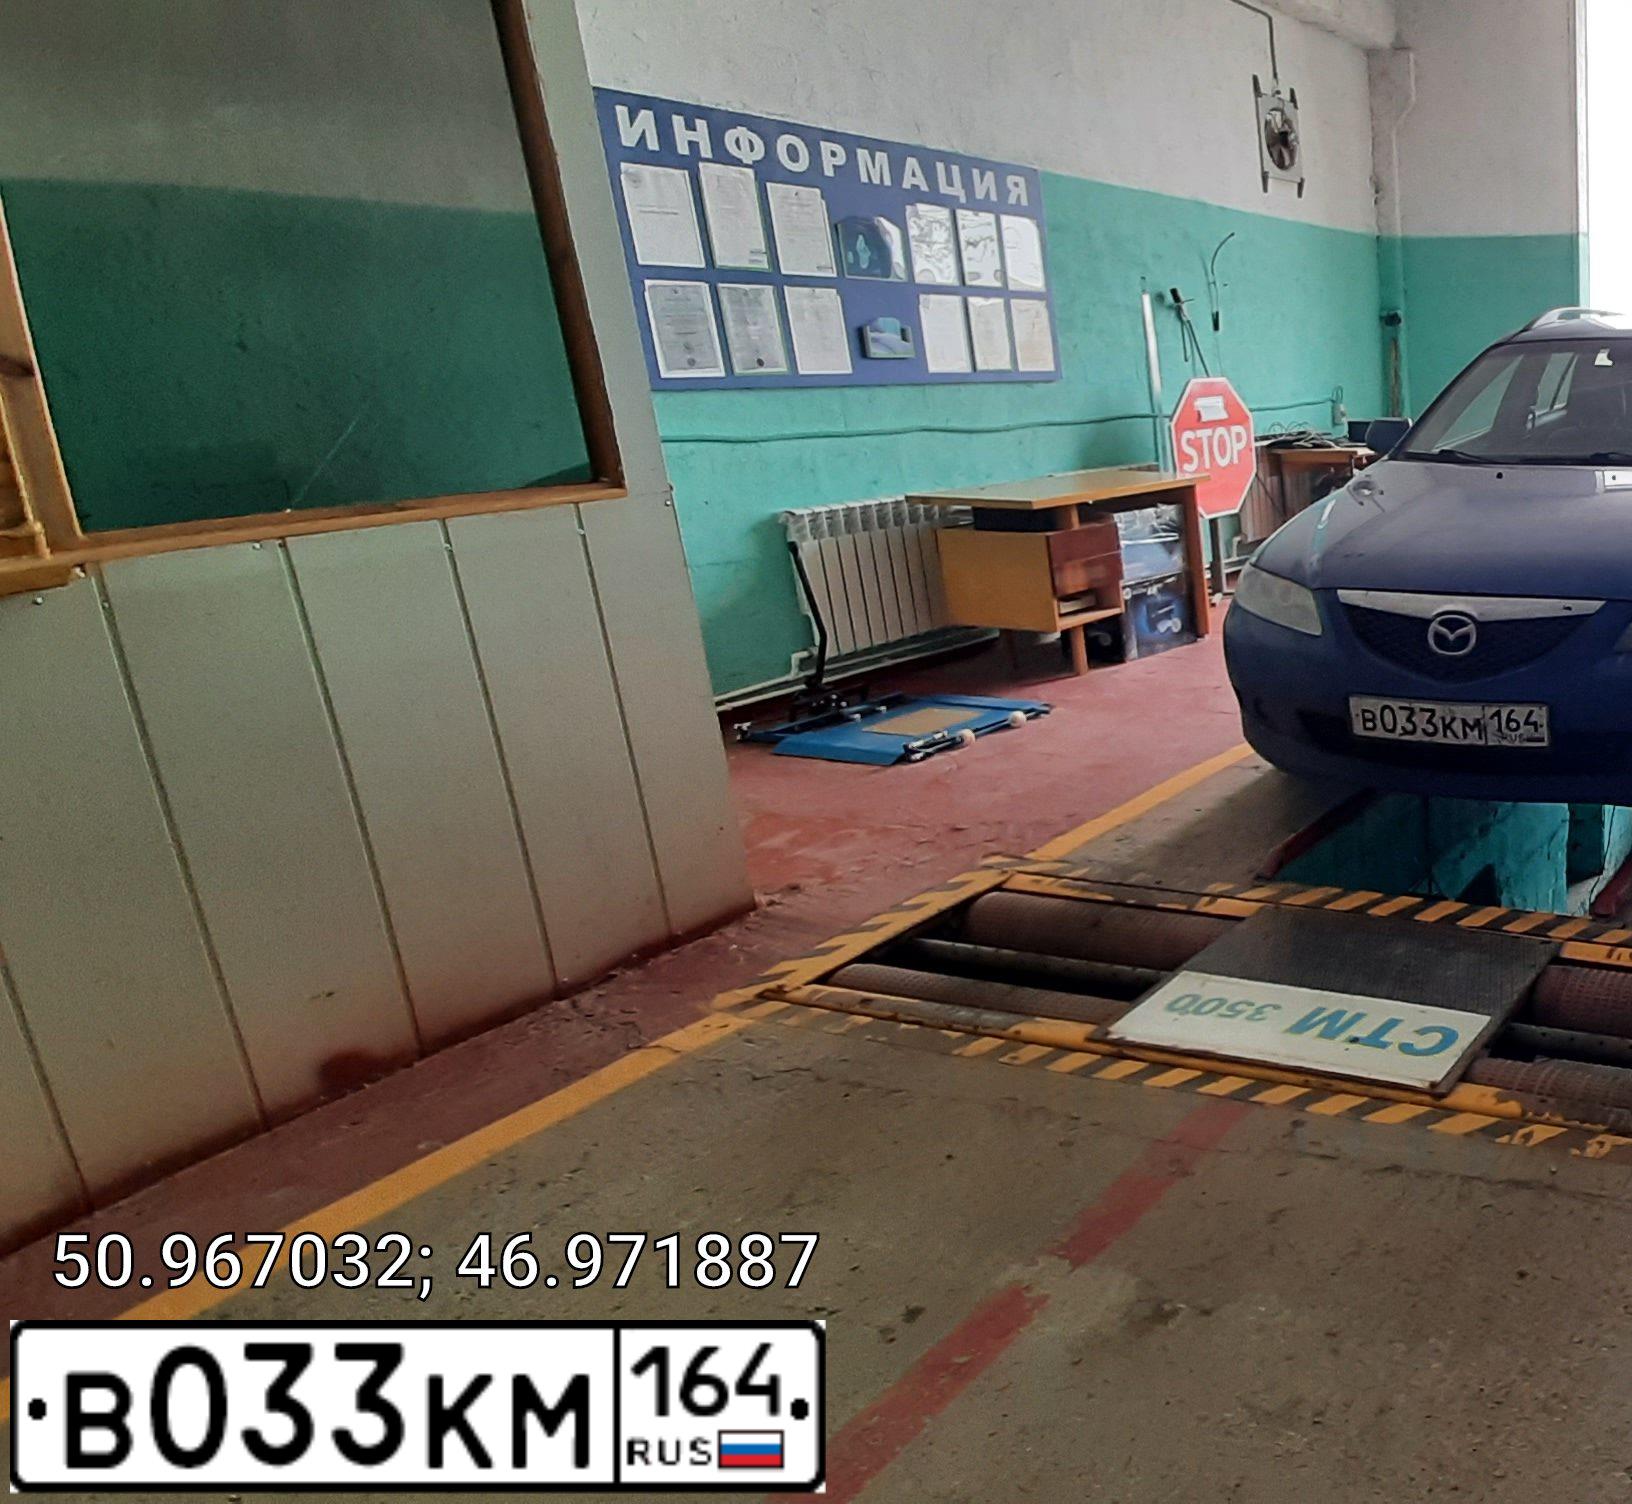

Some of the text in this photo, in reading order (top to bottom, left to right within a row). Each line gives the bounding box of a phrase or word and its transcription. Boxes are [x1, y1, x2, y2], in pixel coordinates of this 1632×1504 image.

[614, 104, 1029, 206] ИНФОРМАЦИЯ
[1180, 425, 1248, 472] STOP
[1361, 704, 1540, 740] В033КМ 164
[1164, 993, 1460, 1056] СТМ 3500
